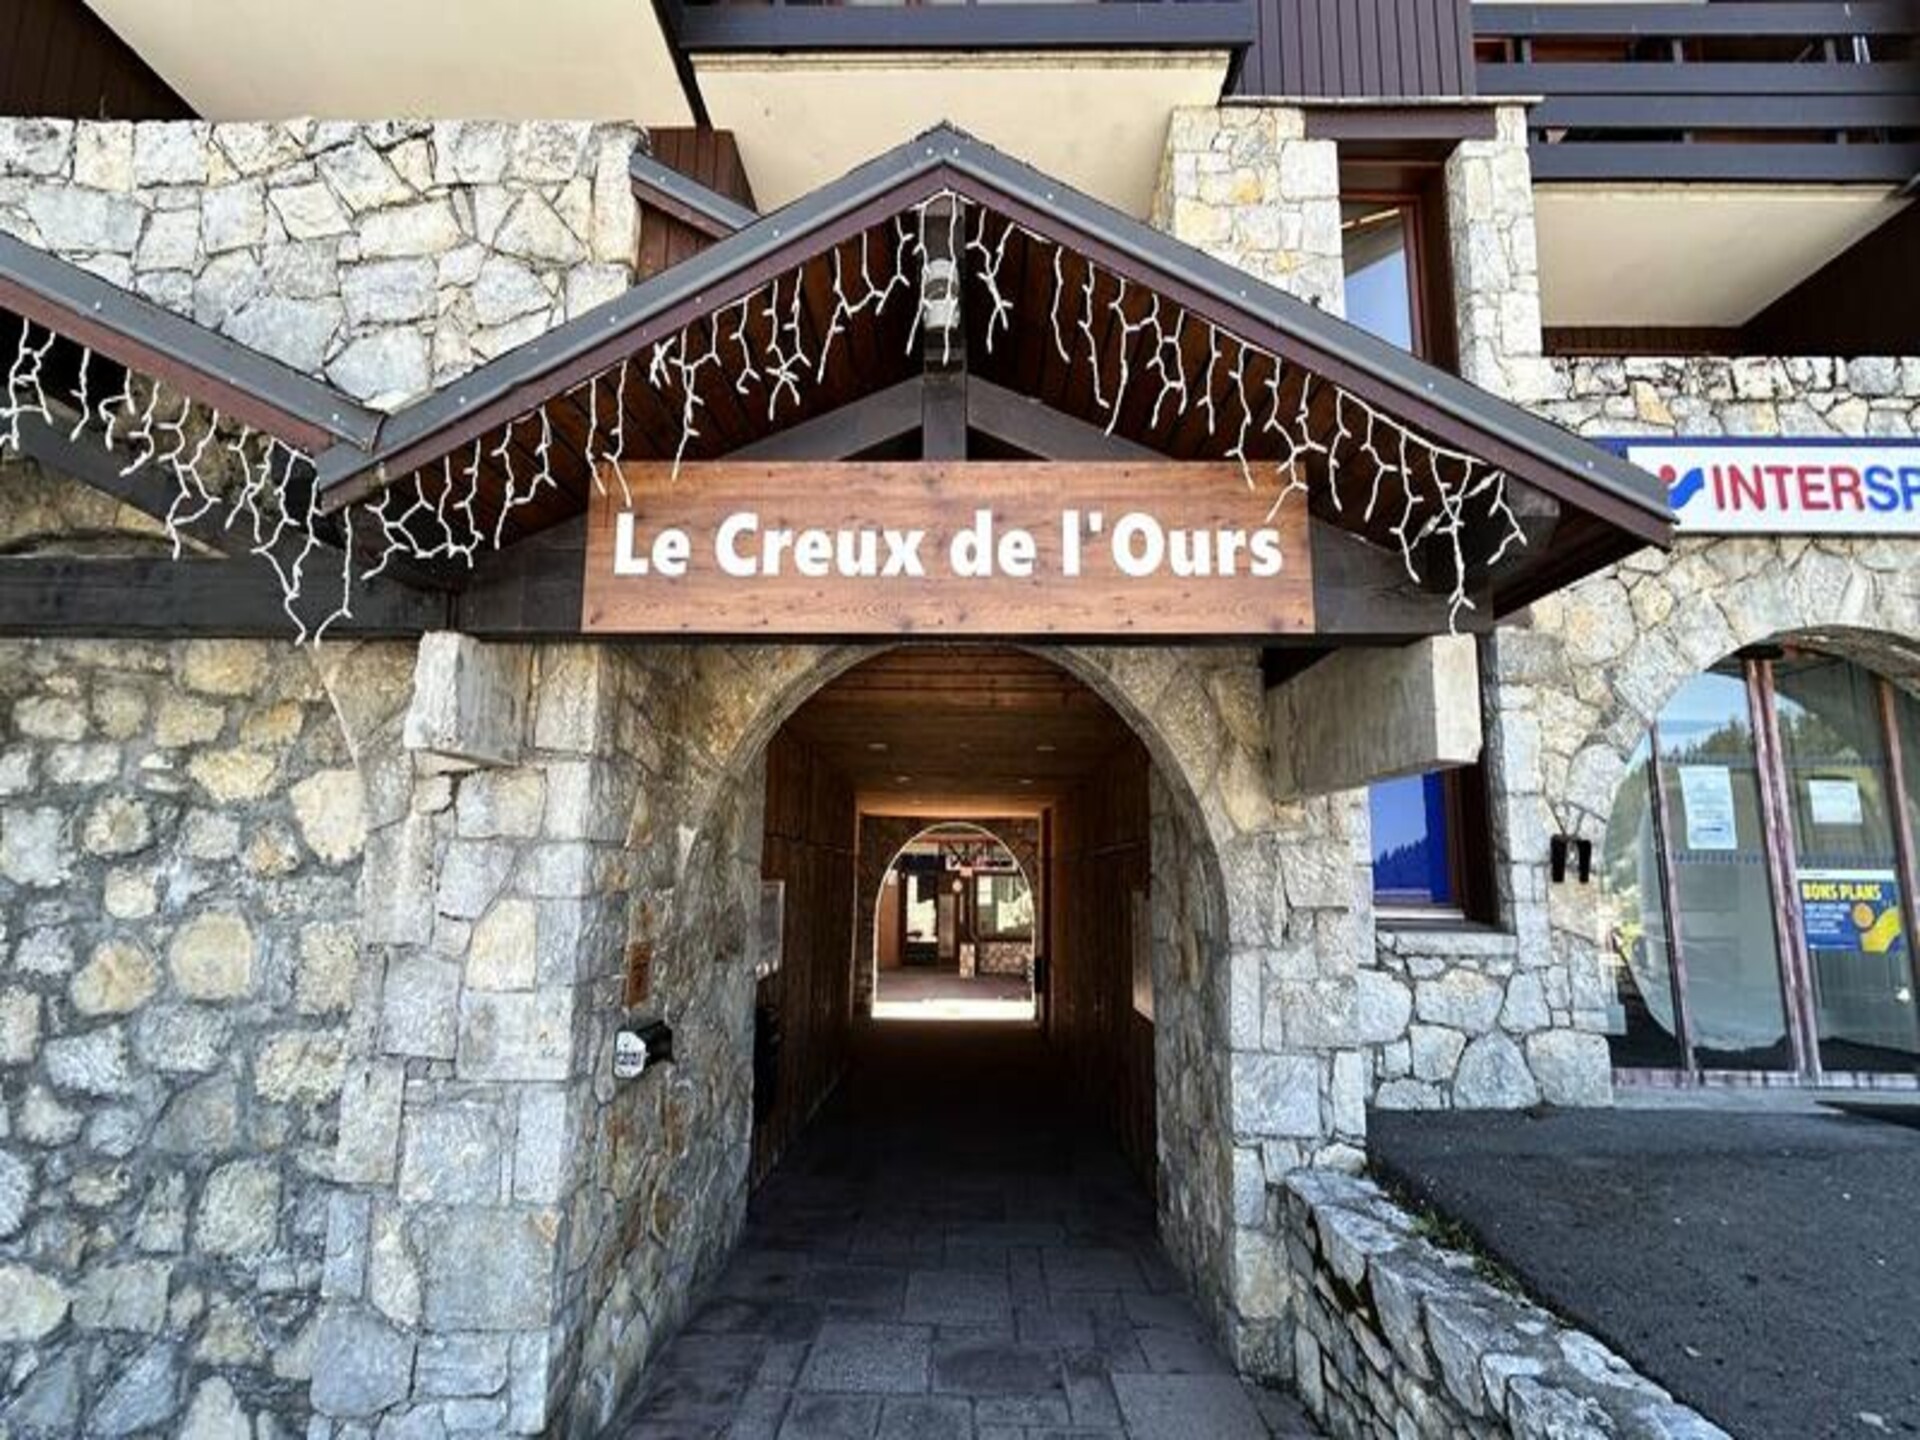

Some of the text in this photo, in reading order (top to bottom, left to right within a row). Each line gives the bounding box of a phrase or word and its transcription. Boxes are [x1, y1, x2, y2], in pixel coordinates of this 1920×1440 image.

[614, 509, 1283, 577] Le Creux de l'Ours
